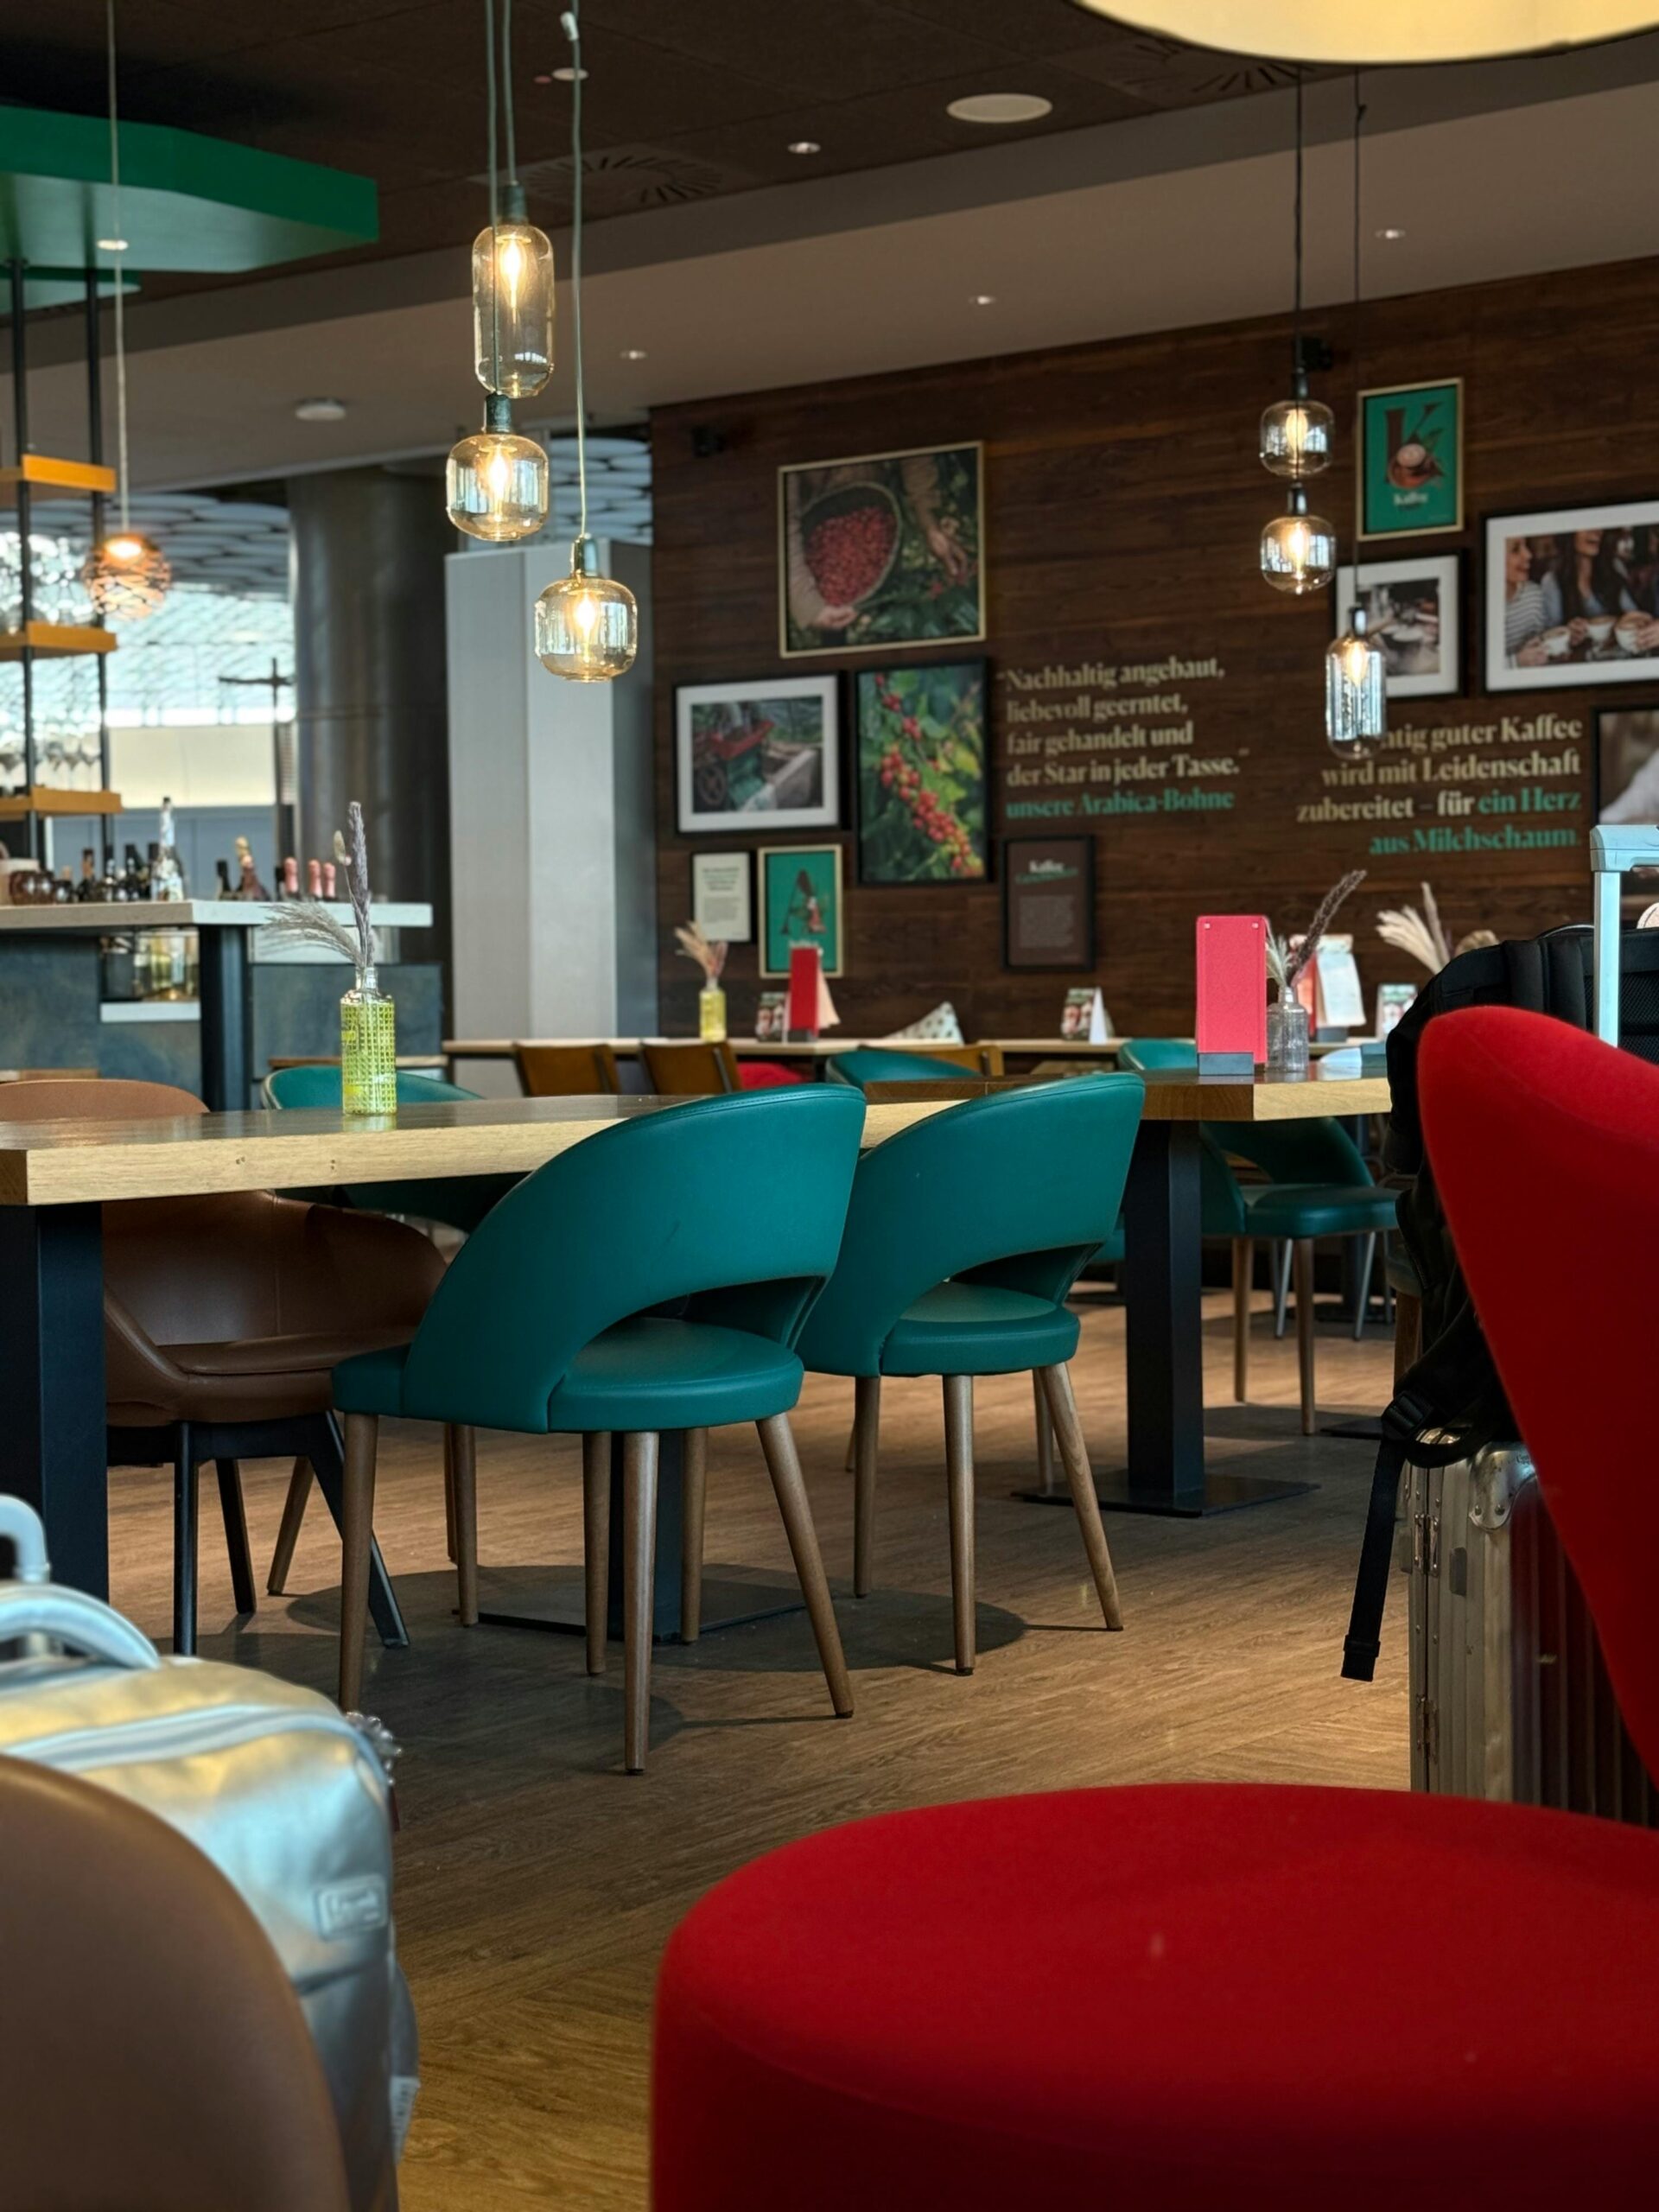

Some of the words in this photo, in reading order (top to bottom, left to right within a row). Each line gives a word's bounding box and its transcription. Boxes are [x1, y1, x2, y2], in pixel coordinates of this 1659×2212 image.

[1119, 655, 1224, 685] angebaut,
[1007, 694, 1090, 723] liebevoll
[1093, 693, 1188, 722] geerntet,
[1007, 731, 1041, 755] fair
[1045, 725, 1147, 757] gehandelt
[1150, 720, 1194, 747] und
[1432, 722, 1497, 753] guter
[1501, 713, 1583, 743] Kaffee
[1007, 764, 1041, 787] der
[1044, 760, 1088, 785] Star
[1090, 760, 1111, 782] in
[1113, 756, 1168, 785] jeder
[1322, 760, 1375, 786] wird
[1378, 758, 1417, 784] mit
[1422, 748, 1580, 781] Leidenschaft
[1006, 799, 1074, 818] unsere
[1297, 795, 1414, 822] zubereitet
[1437, 790, 1476, 817] für
[1478, 790, 1516, 813] ein
[1521, 785, 1581, 812] Herz
[1370, 836, 1410, 855] aus
